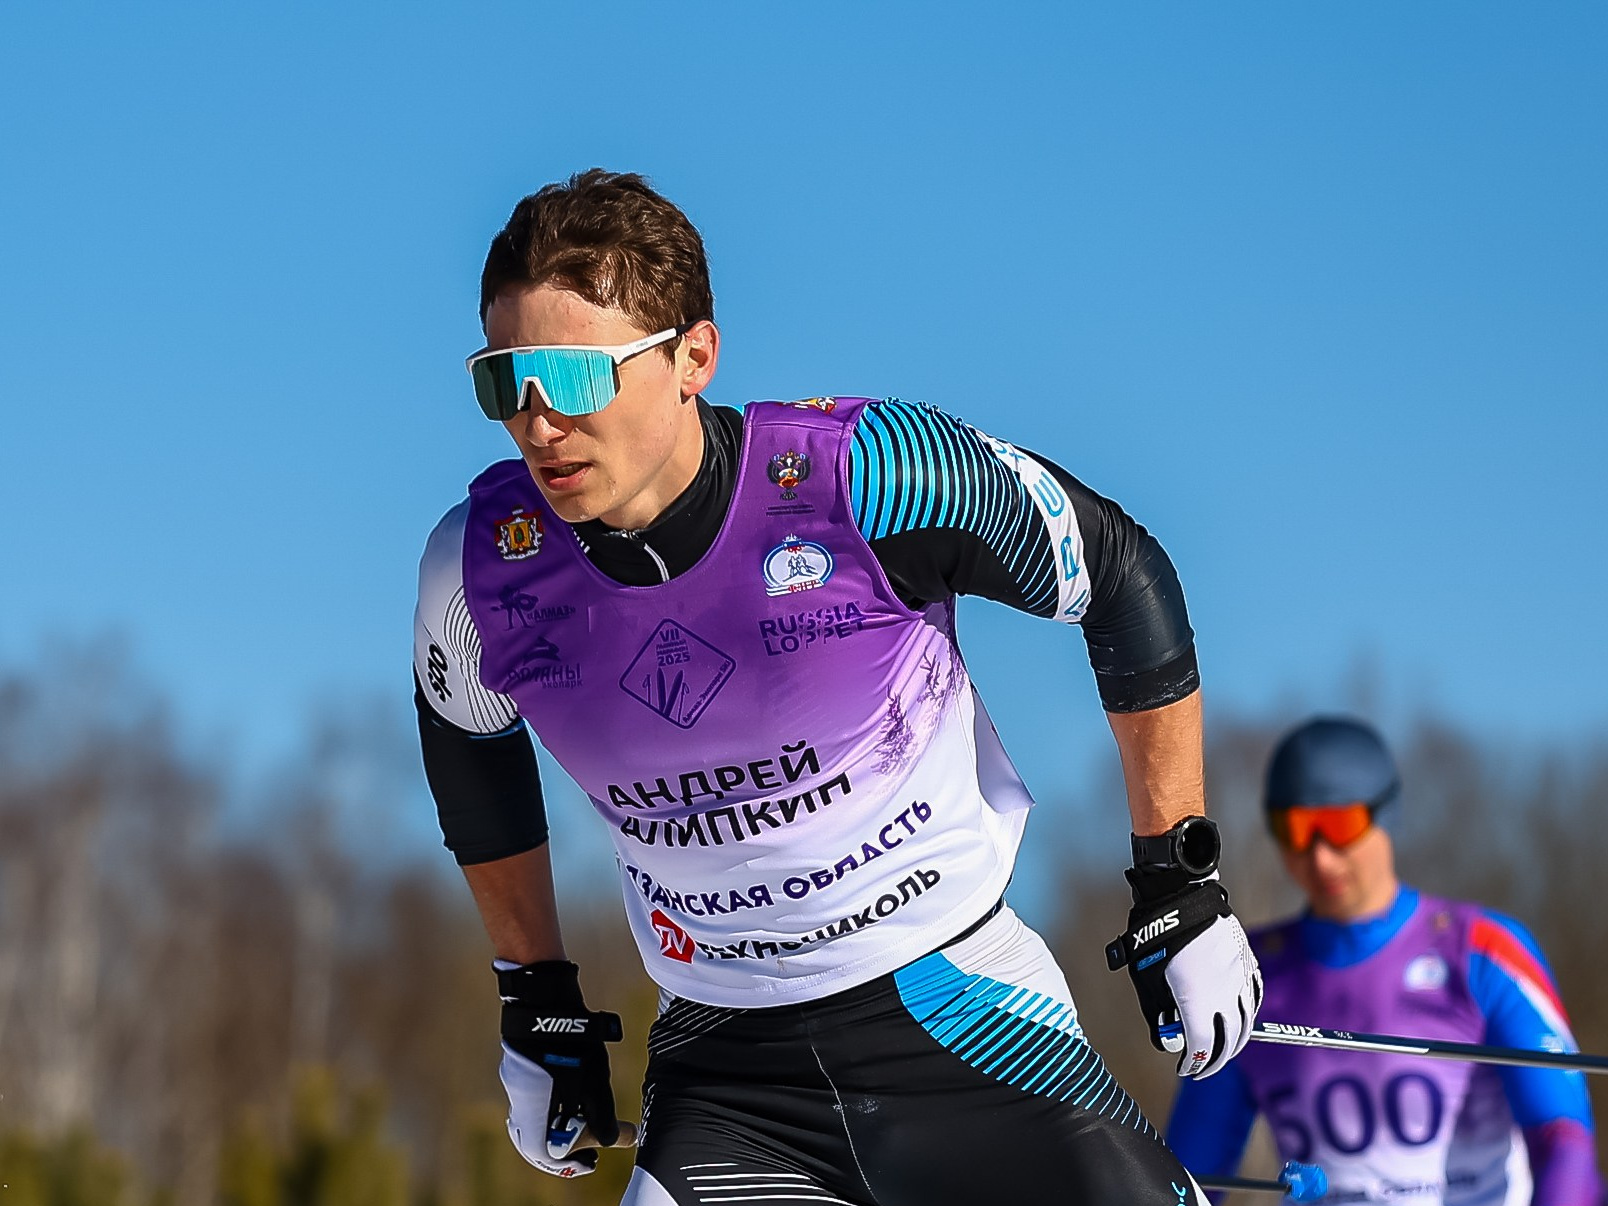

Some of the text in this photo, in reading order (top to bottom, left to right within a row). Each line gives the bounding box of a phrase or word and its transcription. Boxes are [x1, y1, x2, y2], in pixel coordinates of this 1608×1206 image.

[659, 628, 680, 642] VII
[758, 601, 863, 638] RUSSIA
[763, 618, 867, 656] LOPPET
[657, 652, 691, 667] 2025
[607, 740, 820, 809] АНДРЕЙ
[782, 800, 932, 899] ОБЛАСТЬ
[1133, 909, 1180, 950] SWIX
[531, 1017, 589, 1033] SWIX
[1262, 1022, 1323, 1038] SWIX
[1268, 1070, 1444, 1163] 500
